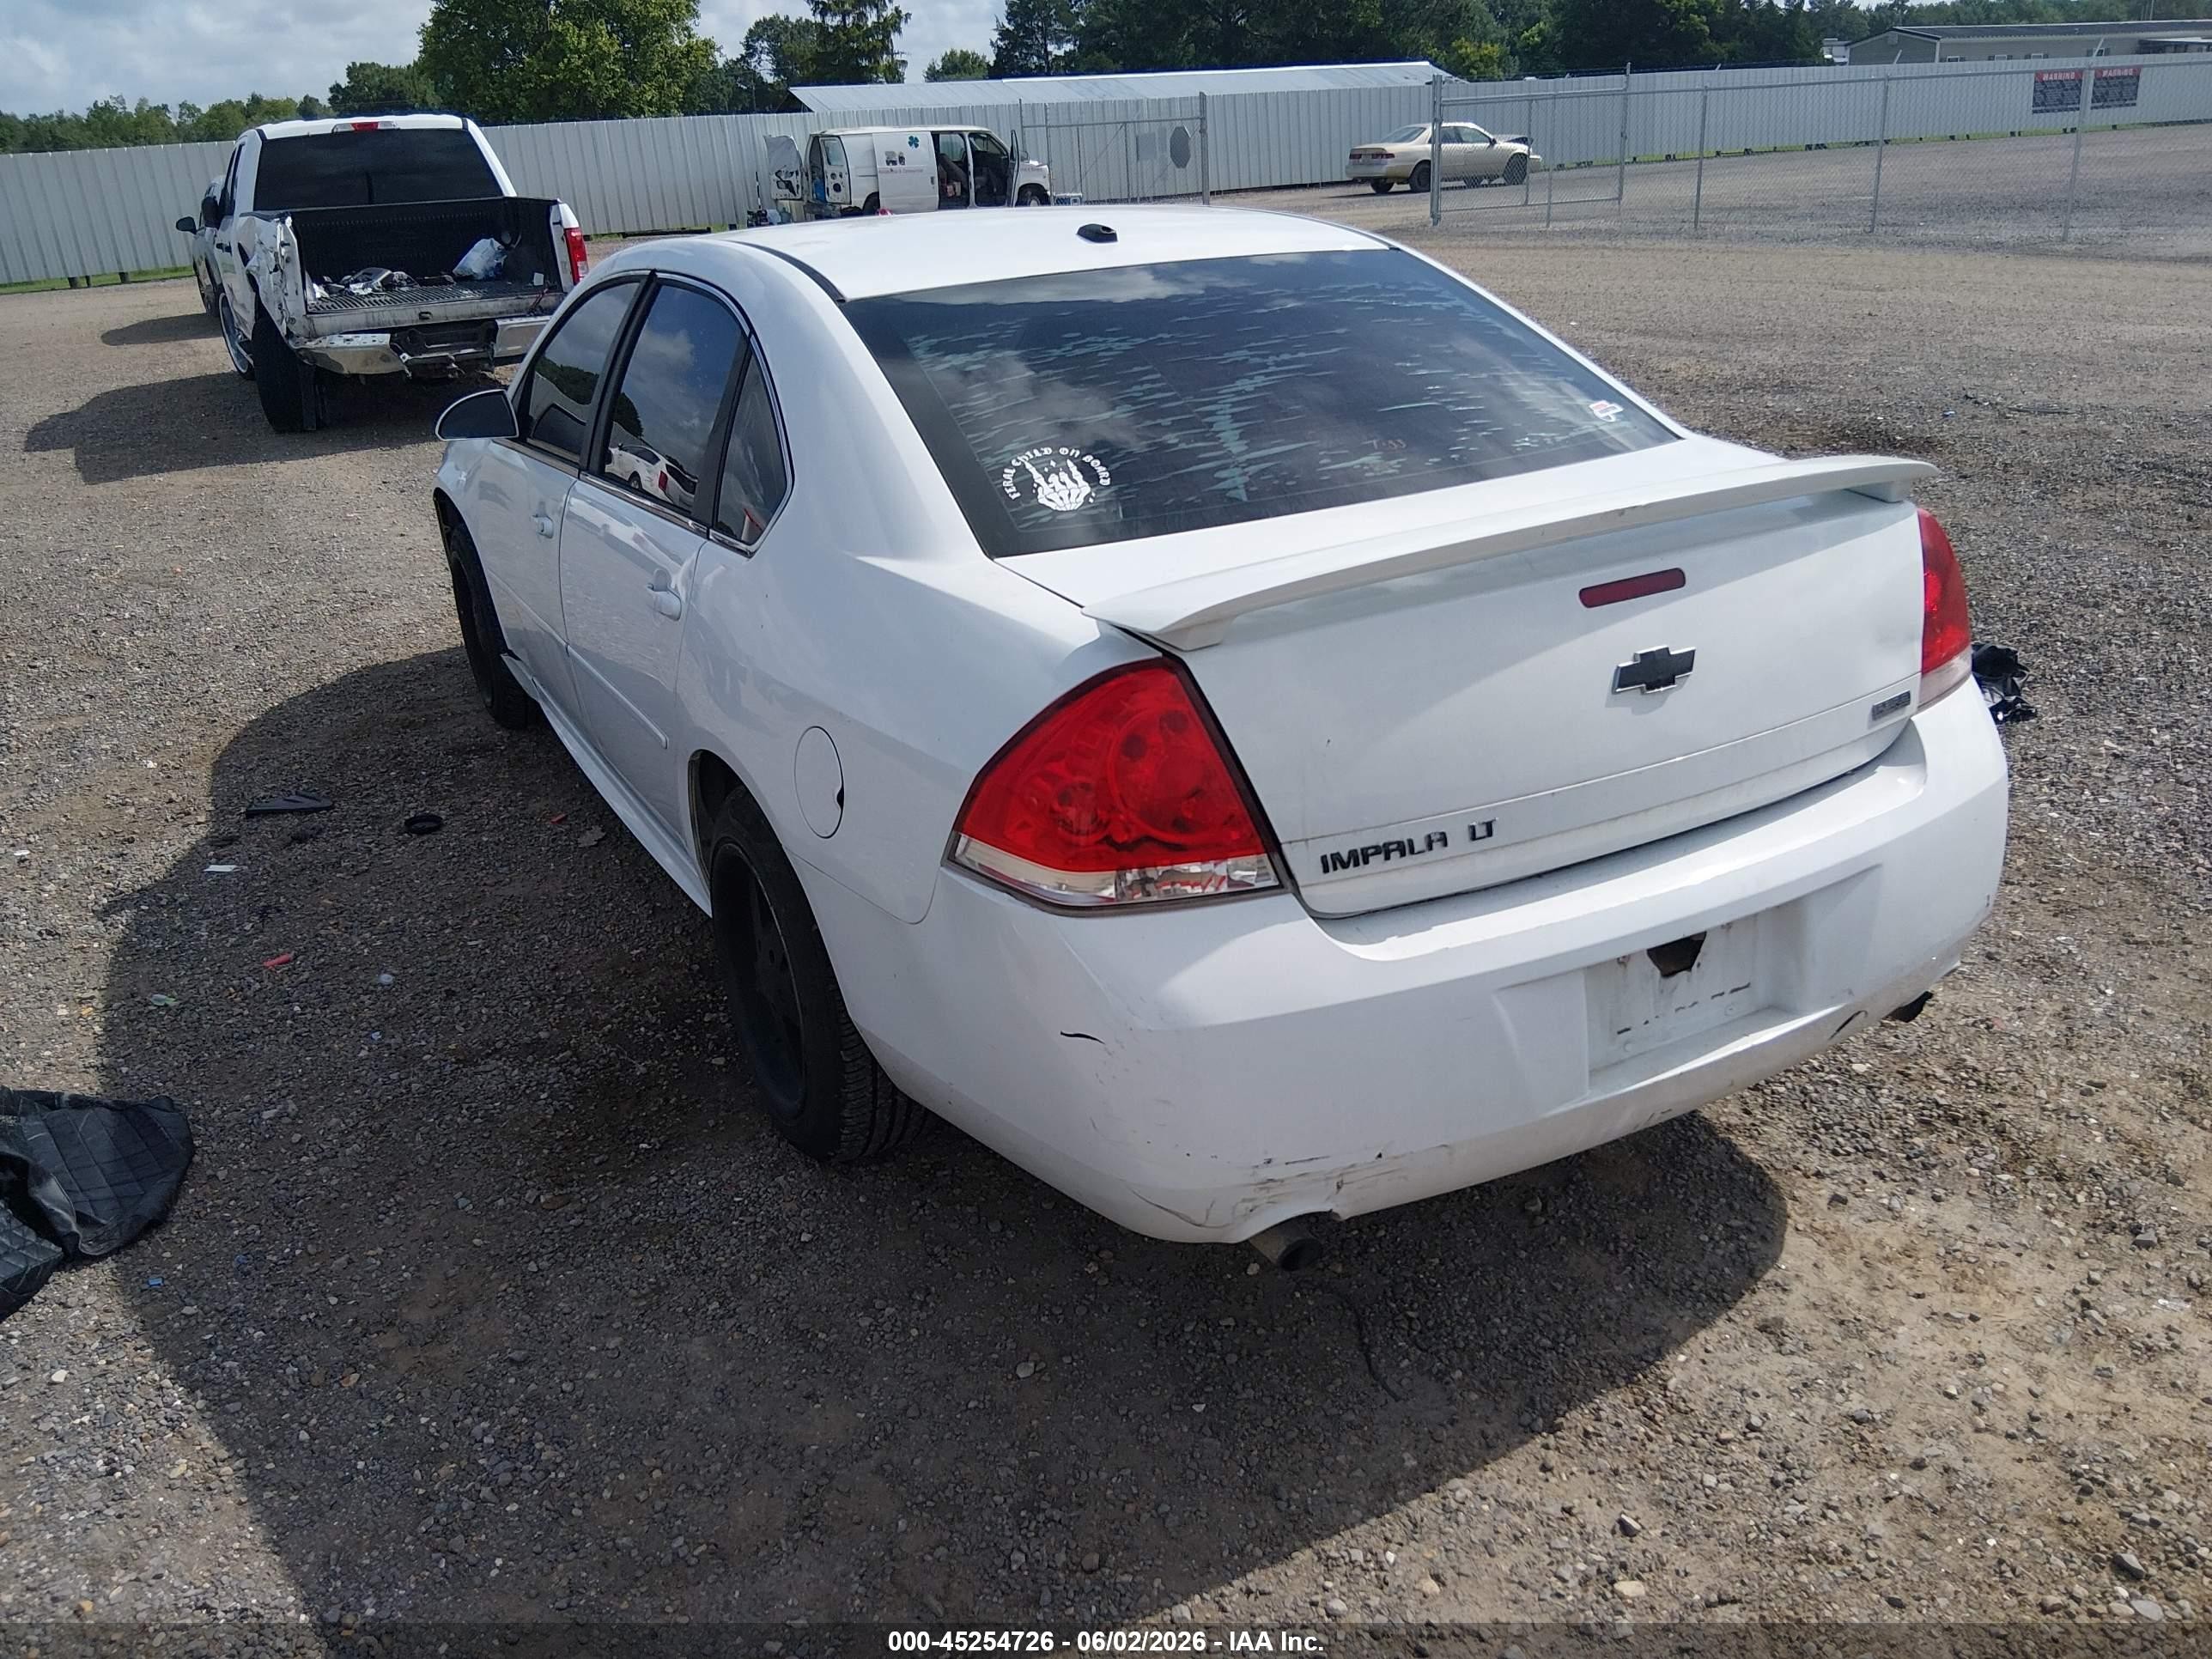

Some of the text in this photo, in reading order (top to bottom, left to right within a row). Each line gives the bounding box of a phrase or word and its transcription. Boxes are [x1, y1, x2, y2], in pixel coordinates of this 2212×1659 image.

[2043, 71, 2075, 81] WARNING
[1002, 467, 1021, 500] FERAL
[1082, 454, 1111, 486] BOARD
[1320, 817, 1499, 874] IMPALA LT
